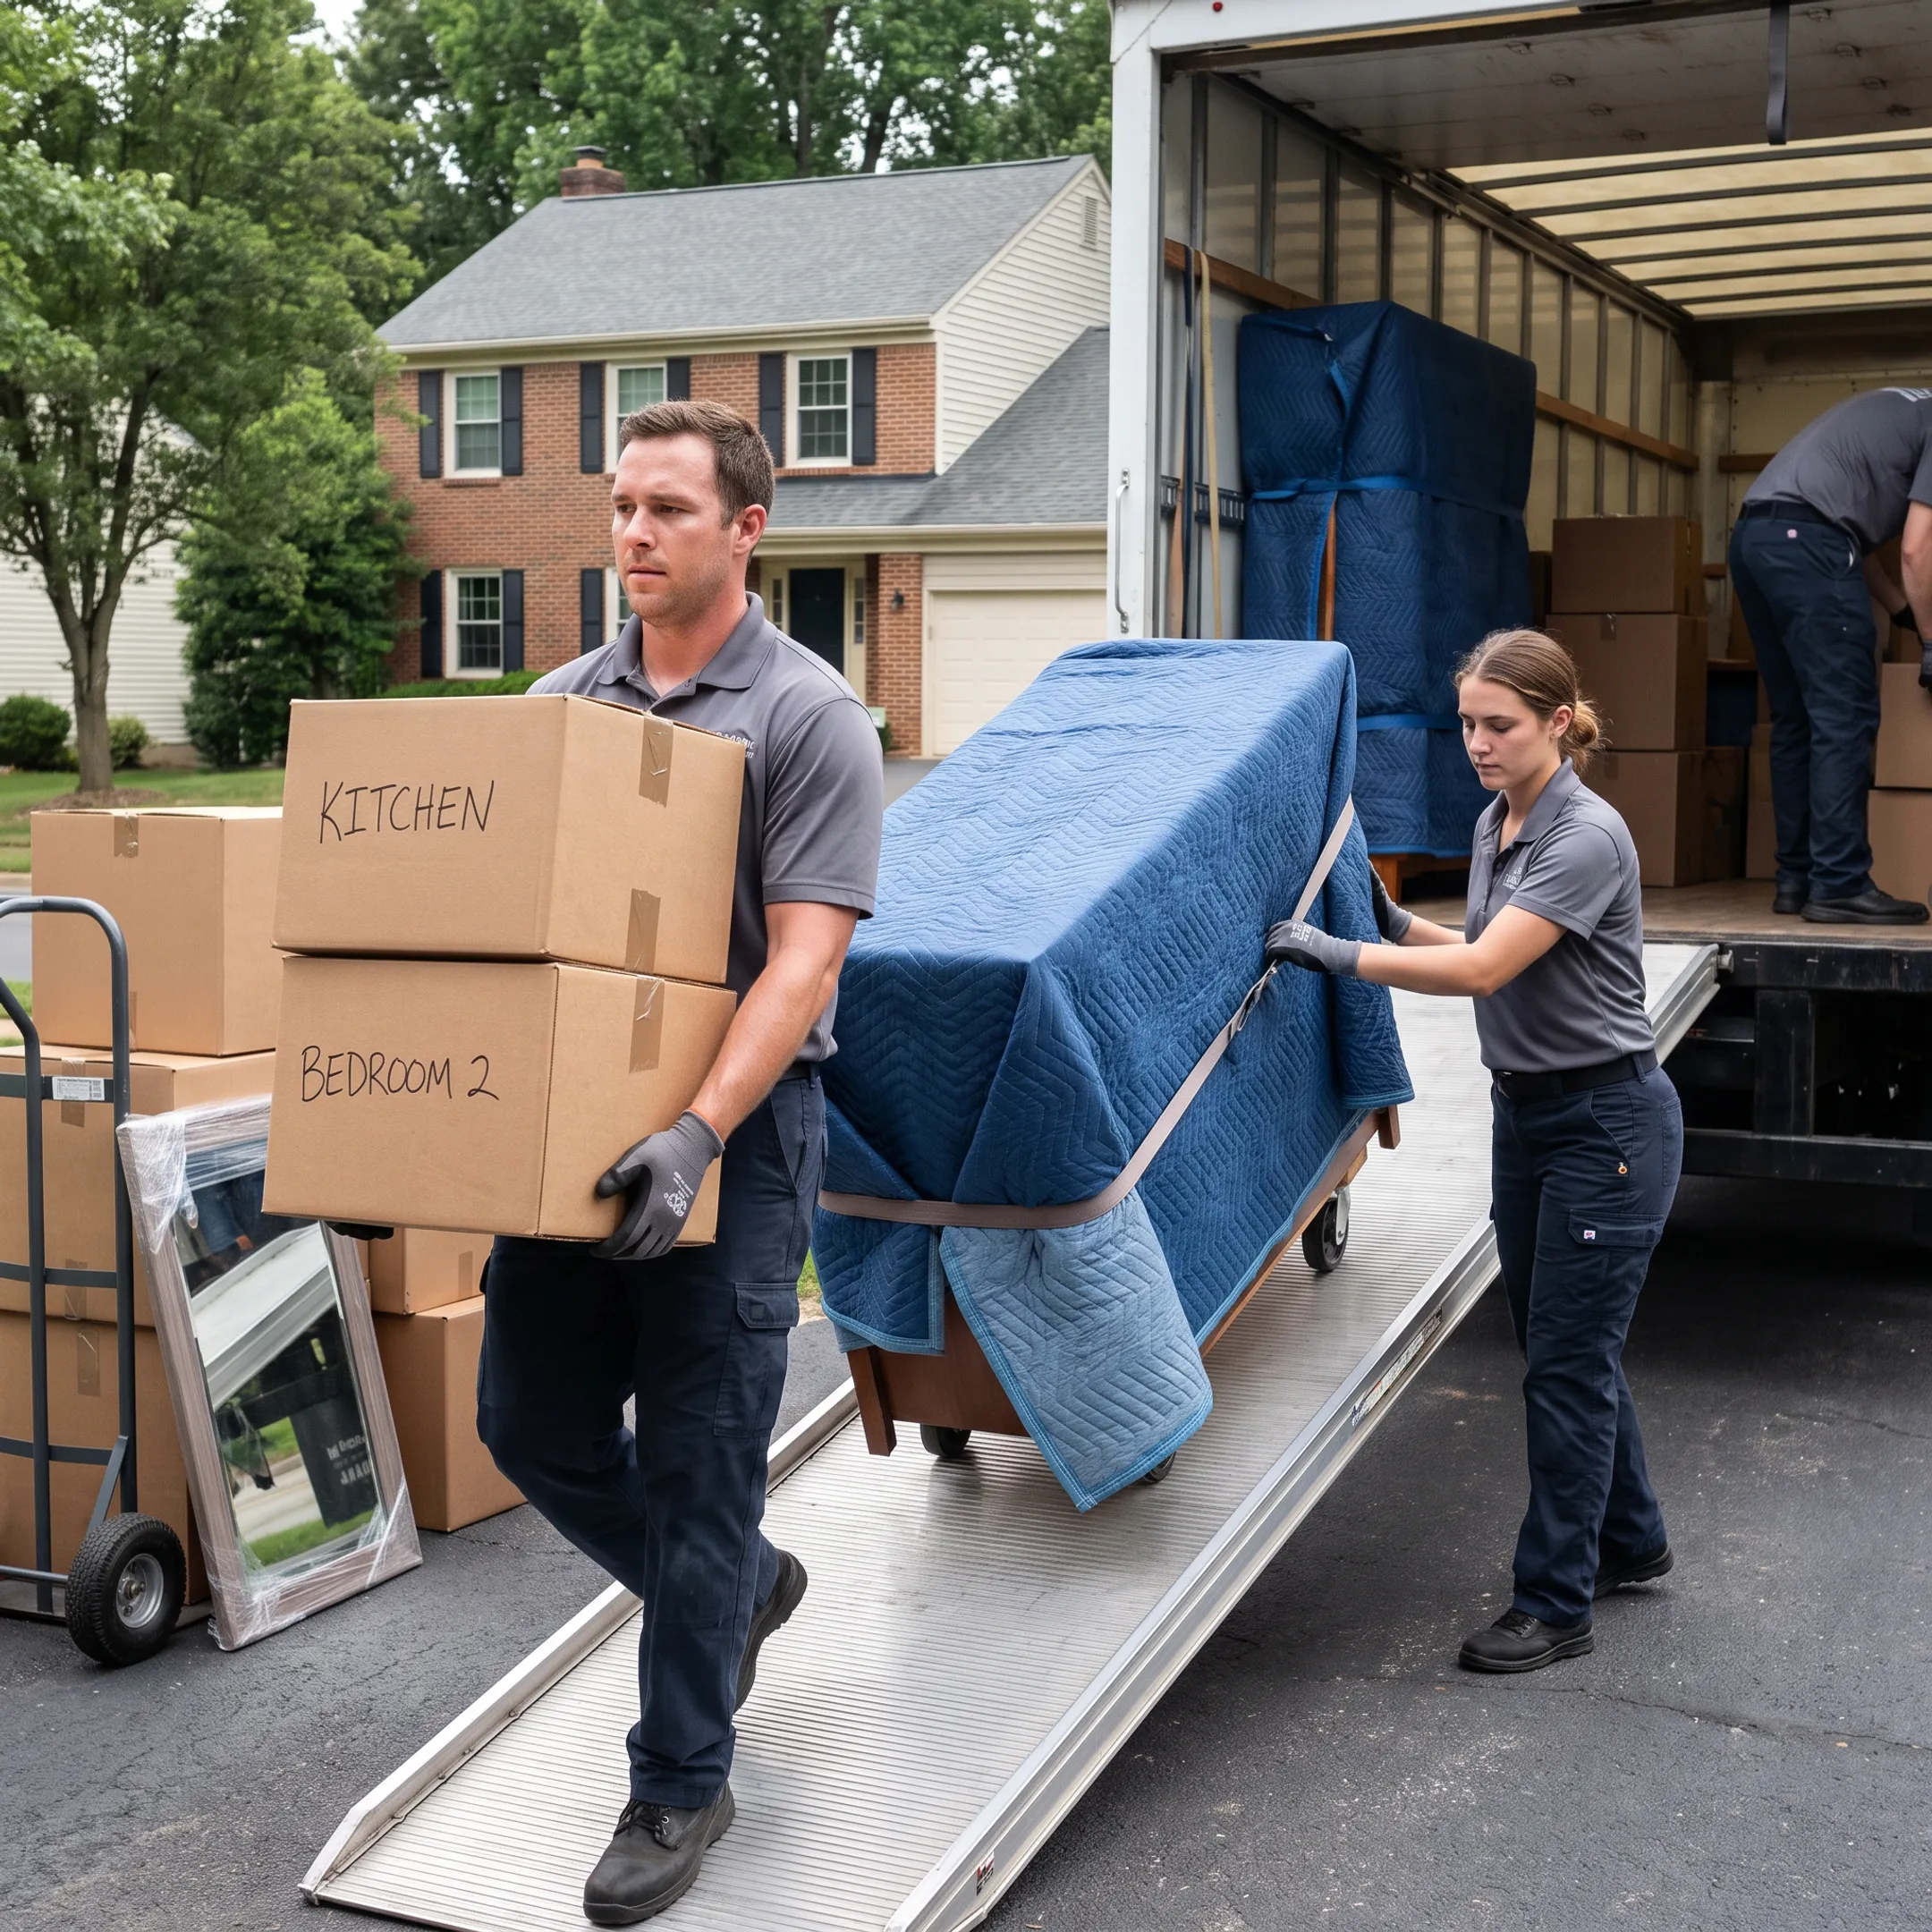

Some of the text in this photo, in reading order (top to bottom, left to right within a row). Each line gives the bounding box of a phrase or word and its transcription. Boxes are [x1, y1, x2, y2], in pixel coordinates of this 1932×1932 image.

[319, 780, 495, 844] KITCHEN
[301, 1045, 500, 1103] BEDROOM 2
